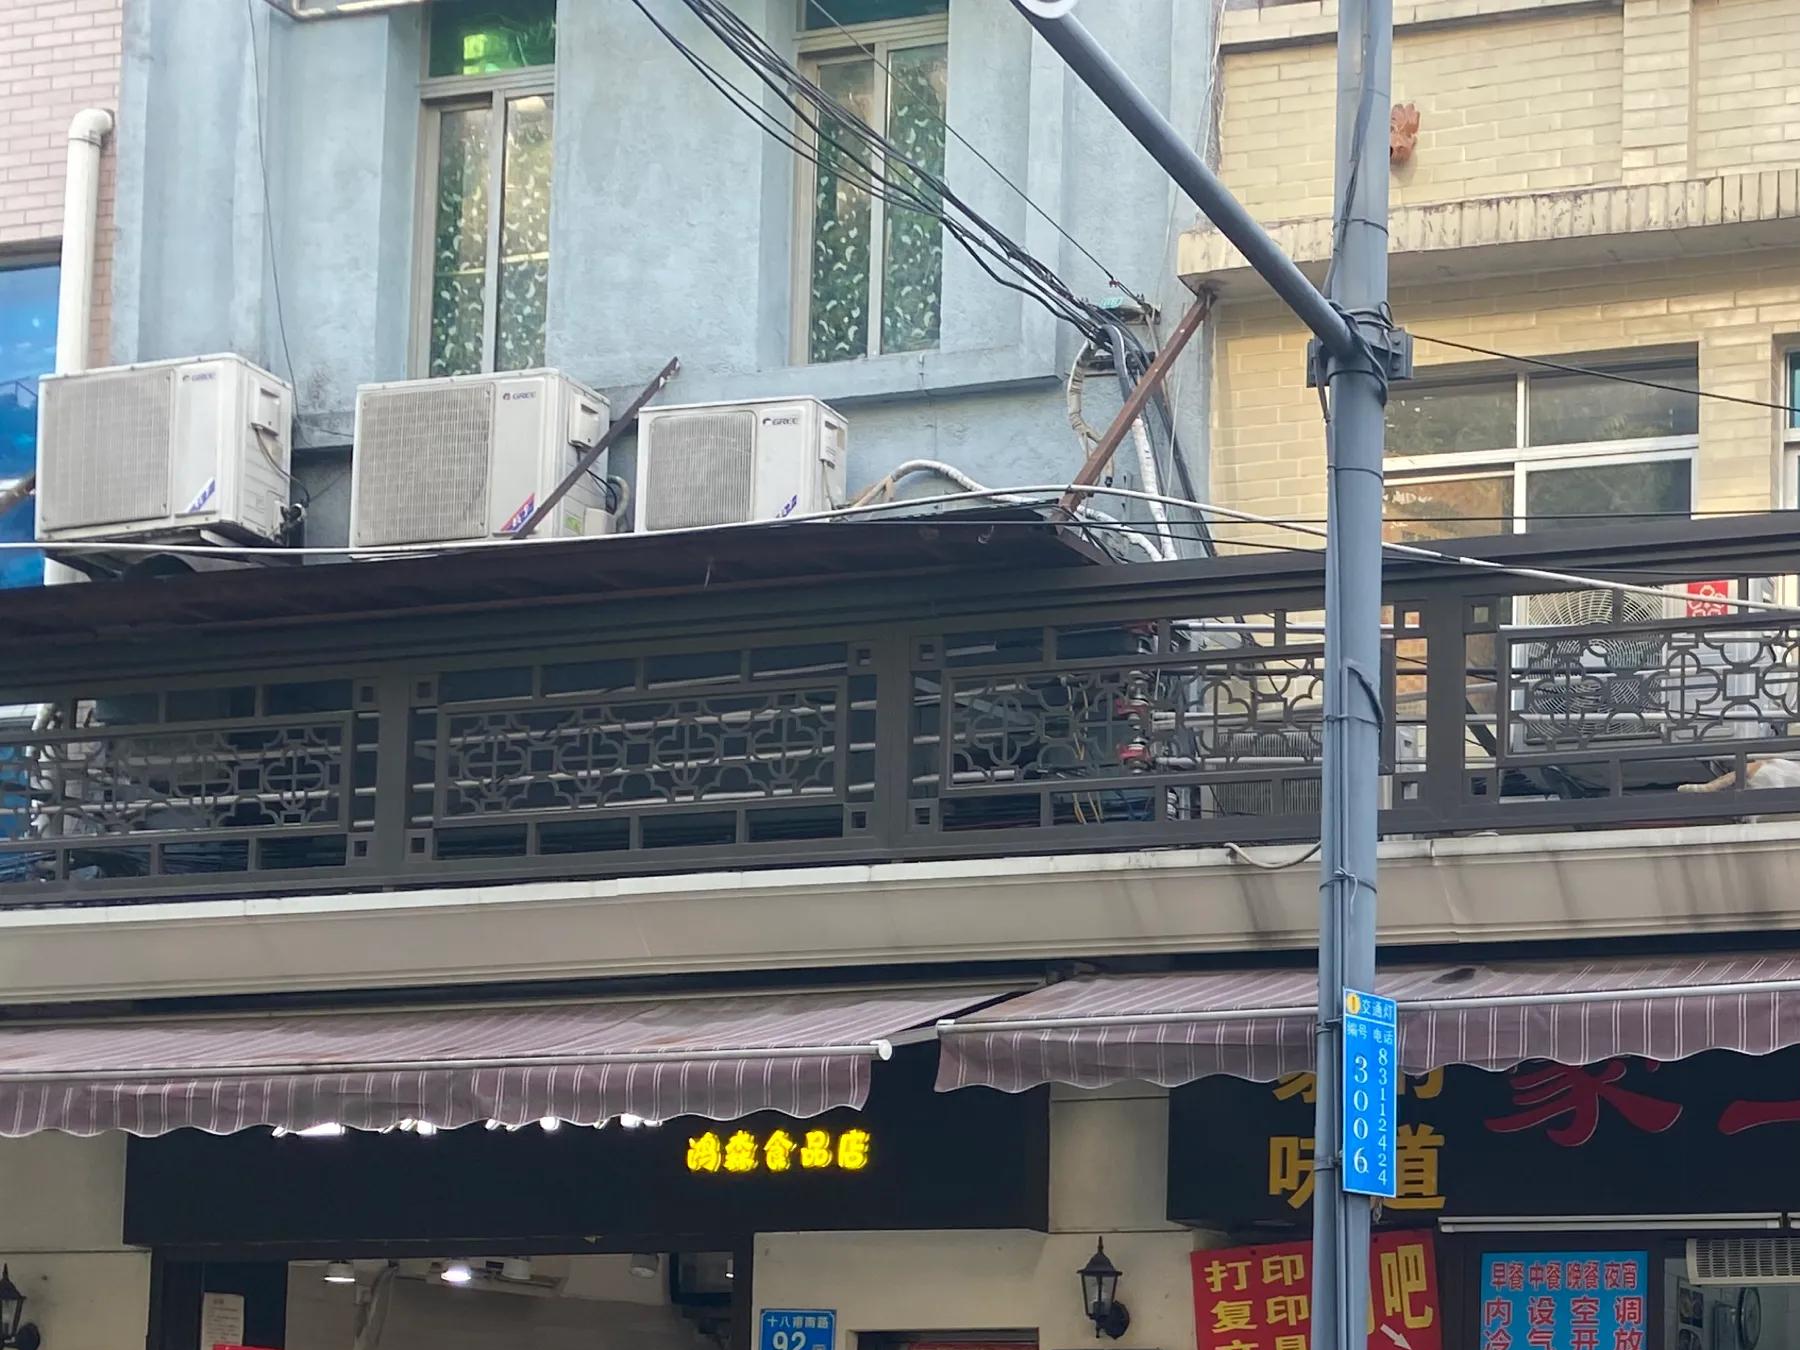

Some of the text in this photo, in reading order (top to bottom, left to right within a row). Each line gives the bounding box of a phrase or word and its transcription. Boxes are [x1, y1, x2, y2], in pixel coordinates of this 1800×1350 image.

[1360, 998, 1393, 1020] 交通灯
[1346, 1023, 1394, 1045] 编号 电话
[1353, 1054, 1369, 1174] 3006
[1378, 1047, 1388, 1187] 83112424
[1204, 1254, 1305, 1292] 打印
[1491, 1260, 1638, 1290] 早餐 中餐 晚餐 夜宵
[766, 1315, 829, 1329] 十八甫南路
[1211, 1295, 1309, 1333] 复印
[1484, 1296, 1643, 1326] 内设空调
